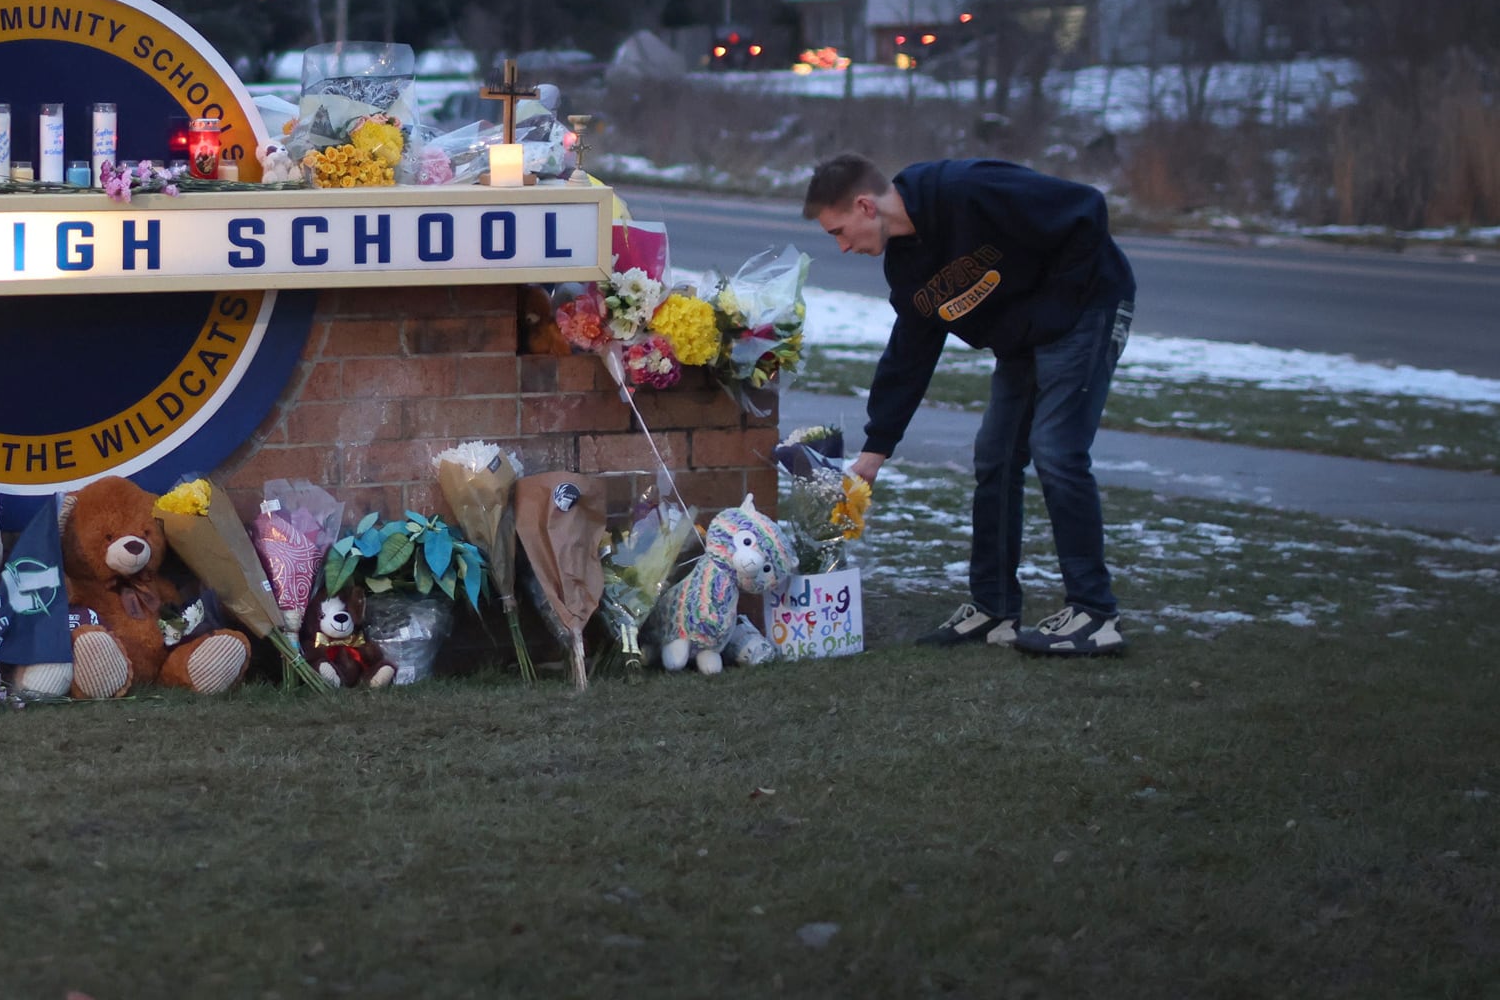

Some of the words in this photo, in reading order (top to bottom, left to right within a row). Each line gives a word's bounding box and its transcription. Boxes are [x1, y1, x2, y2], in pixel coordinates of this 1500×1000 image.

[228, 211, 572, 268] SCHOOL
[913, 245, 1003, 317] OXFORD
[947, 280, 995, 316] FOOTBALL
[2, 440, 76, 472] THE
[91, 296, 248, 458] WILDCATS
[785, 640, 817, 657] ake
